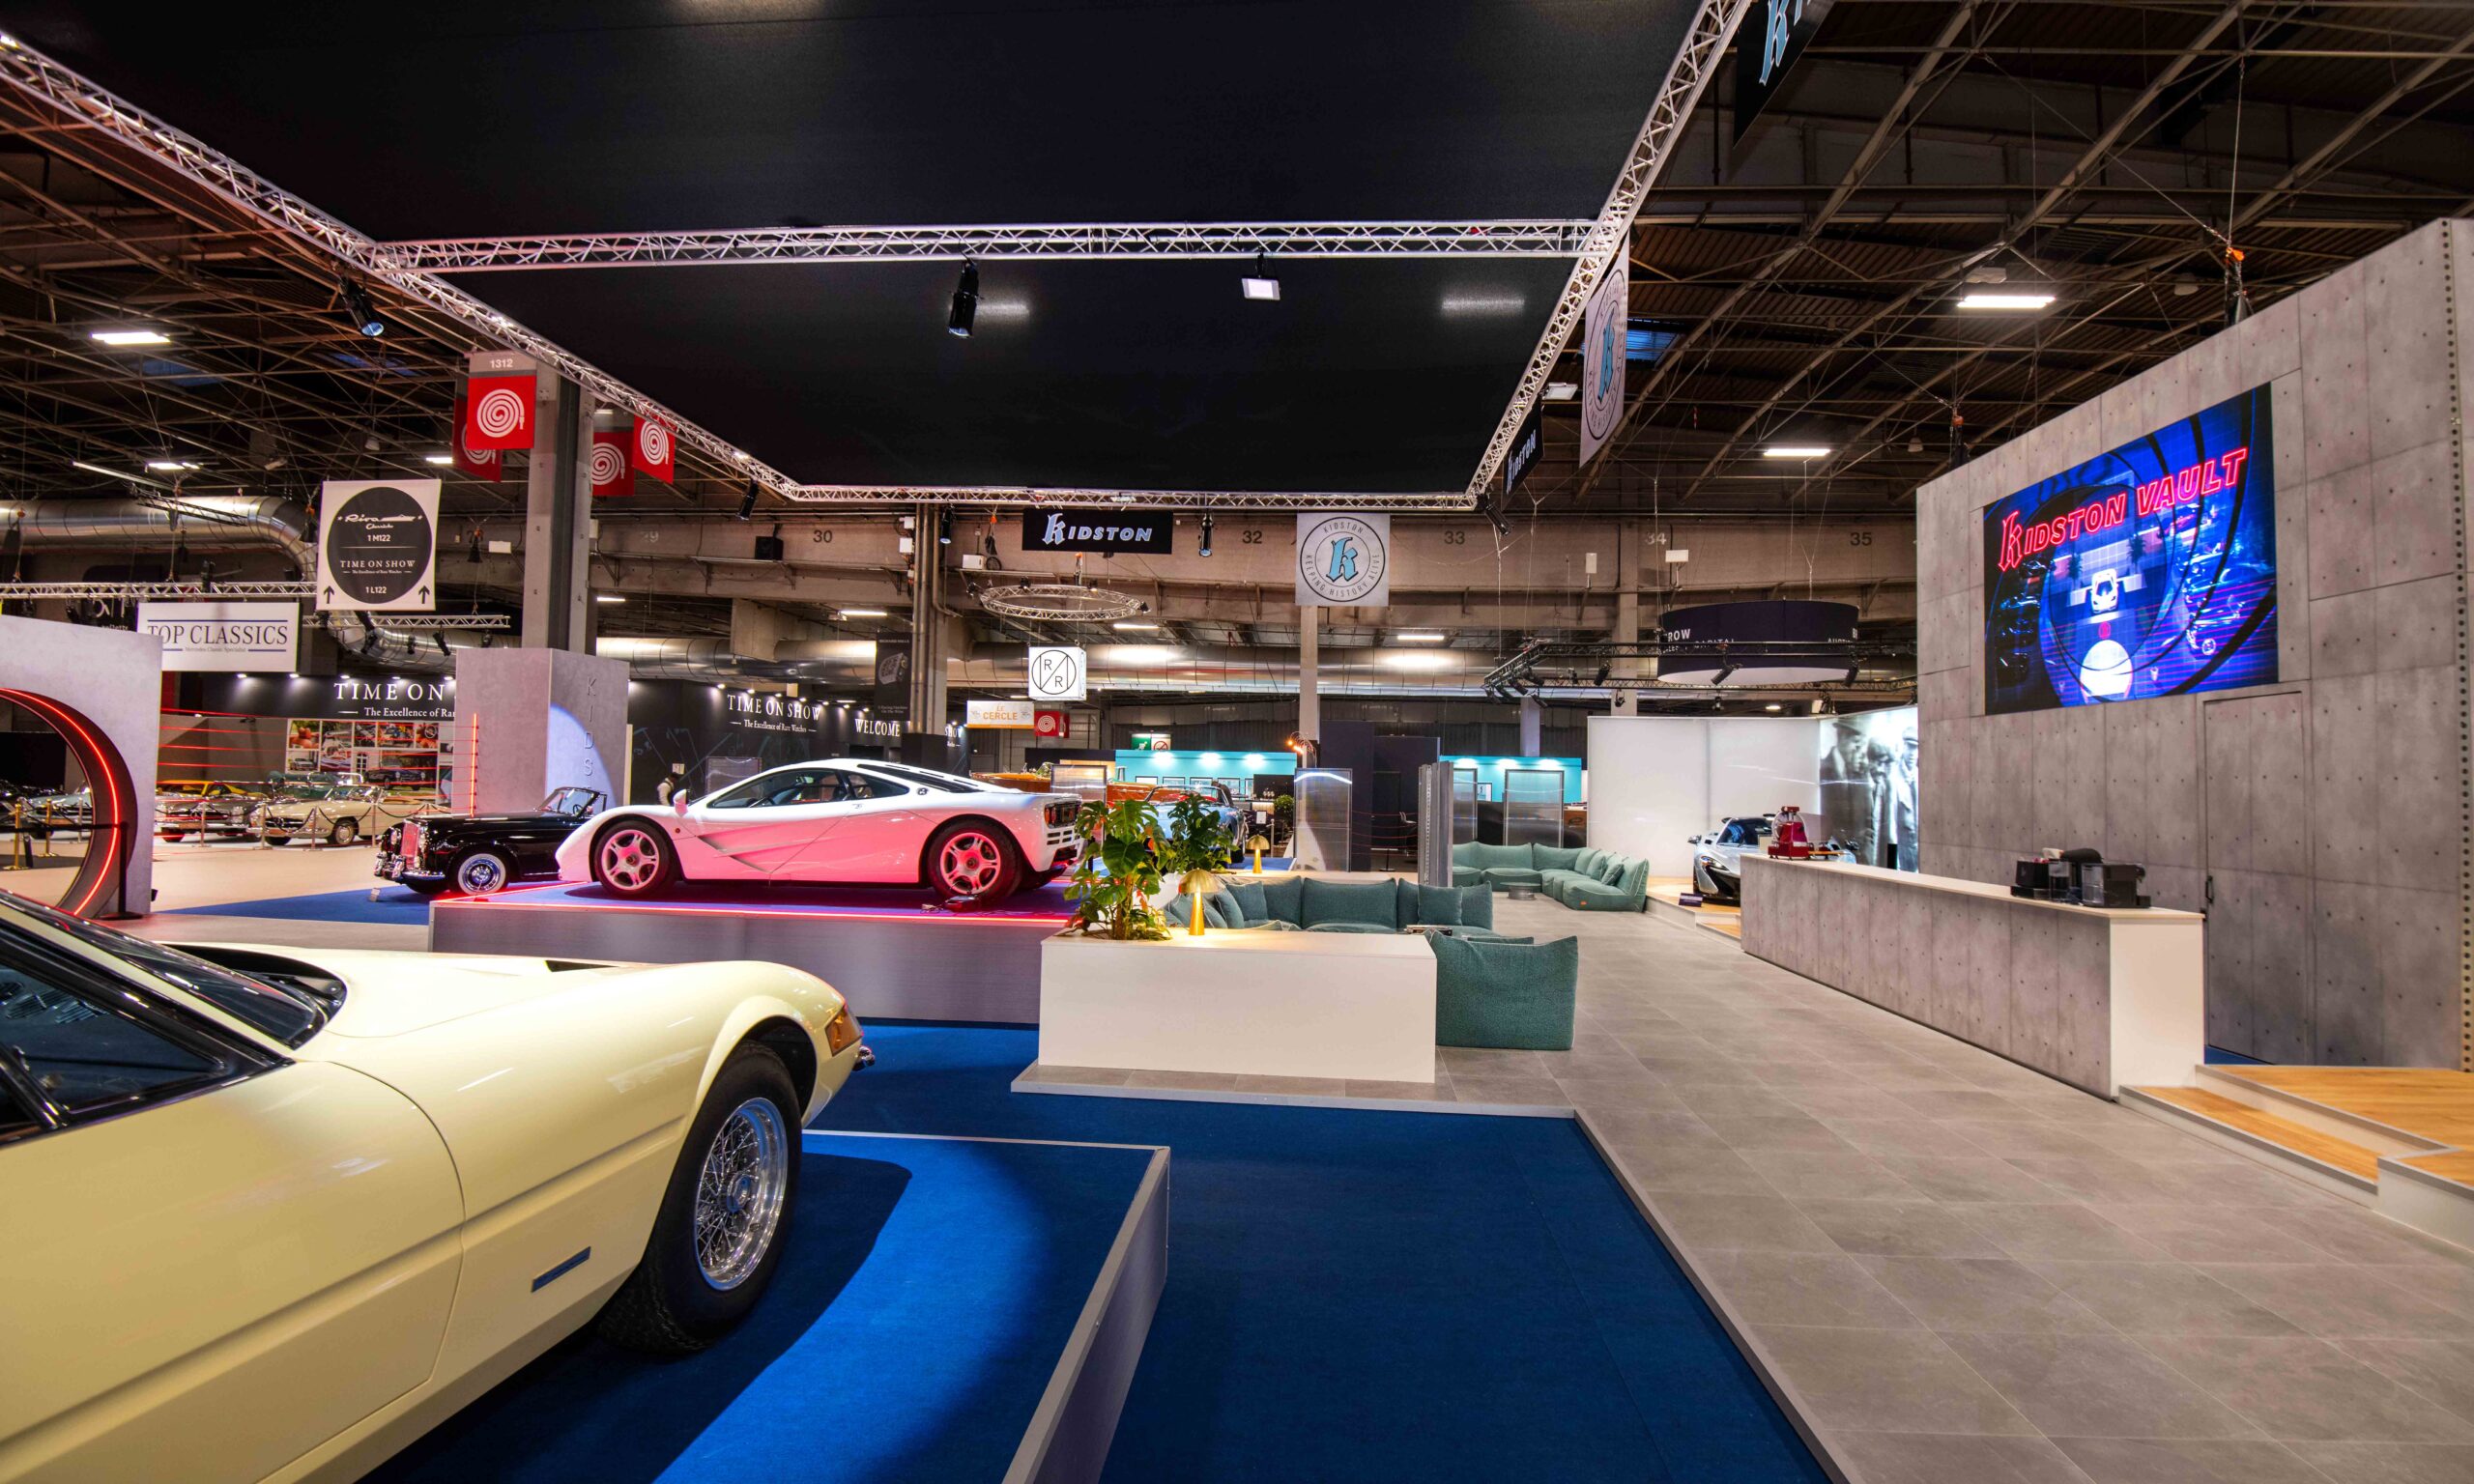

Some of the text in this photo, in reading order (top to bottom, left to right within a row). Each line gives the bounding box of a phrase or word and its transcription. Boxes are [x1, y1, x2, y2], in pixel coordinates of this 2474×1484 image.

[490, 359, 513, 368] 1312
[1507, 429, 1536, 494] KIDSTON
[1998, 447, 2248, 572] KIDSTON VAULT
[345, 514, 379, 522] Riva
[1042, 513, 1152, 545] KIDSTON
[1323, 522, 1363, 533] KIDSTON
[813, 530, 833, 543] 30
[1242, 531, 1262, 544] 32
[1444, 531, 1466, 545] 33
[1644, 532, 1667, 545] 34
[1850, 532, 1872, 546] 35
[191, 625, 288, 645] CLASSICS
[1044, 659, 1052, 670] R
[1055, 676, 1063, 687] R
[334, 683, 444, 701] TIME ON
[364, 707, 381, 716] The
[384, 707, 427, 717] Excellence
[429, 708, 440, 717] of
[727, 694, 821, 721] TIME ON SHOW
[744, 719, 753, 728] The
[855, 718, 900, 737] WELCOME
